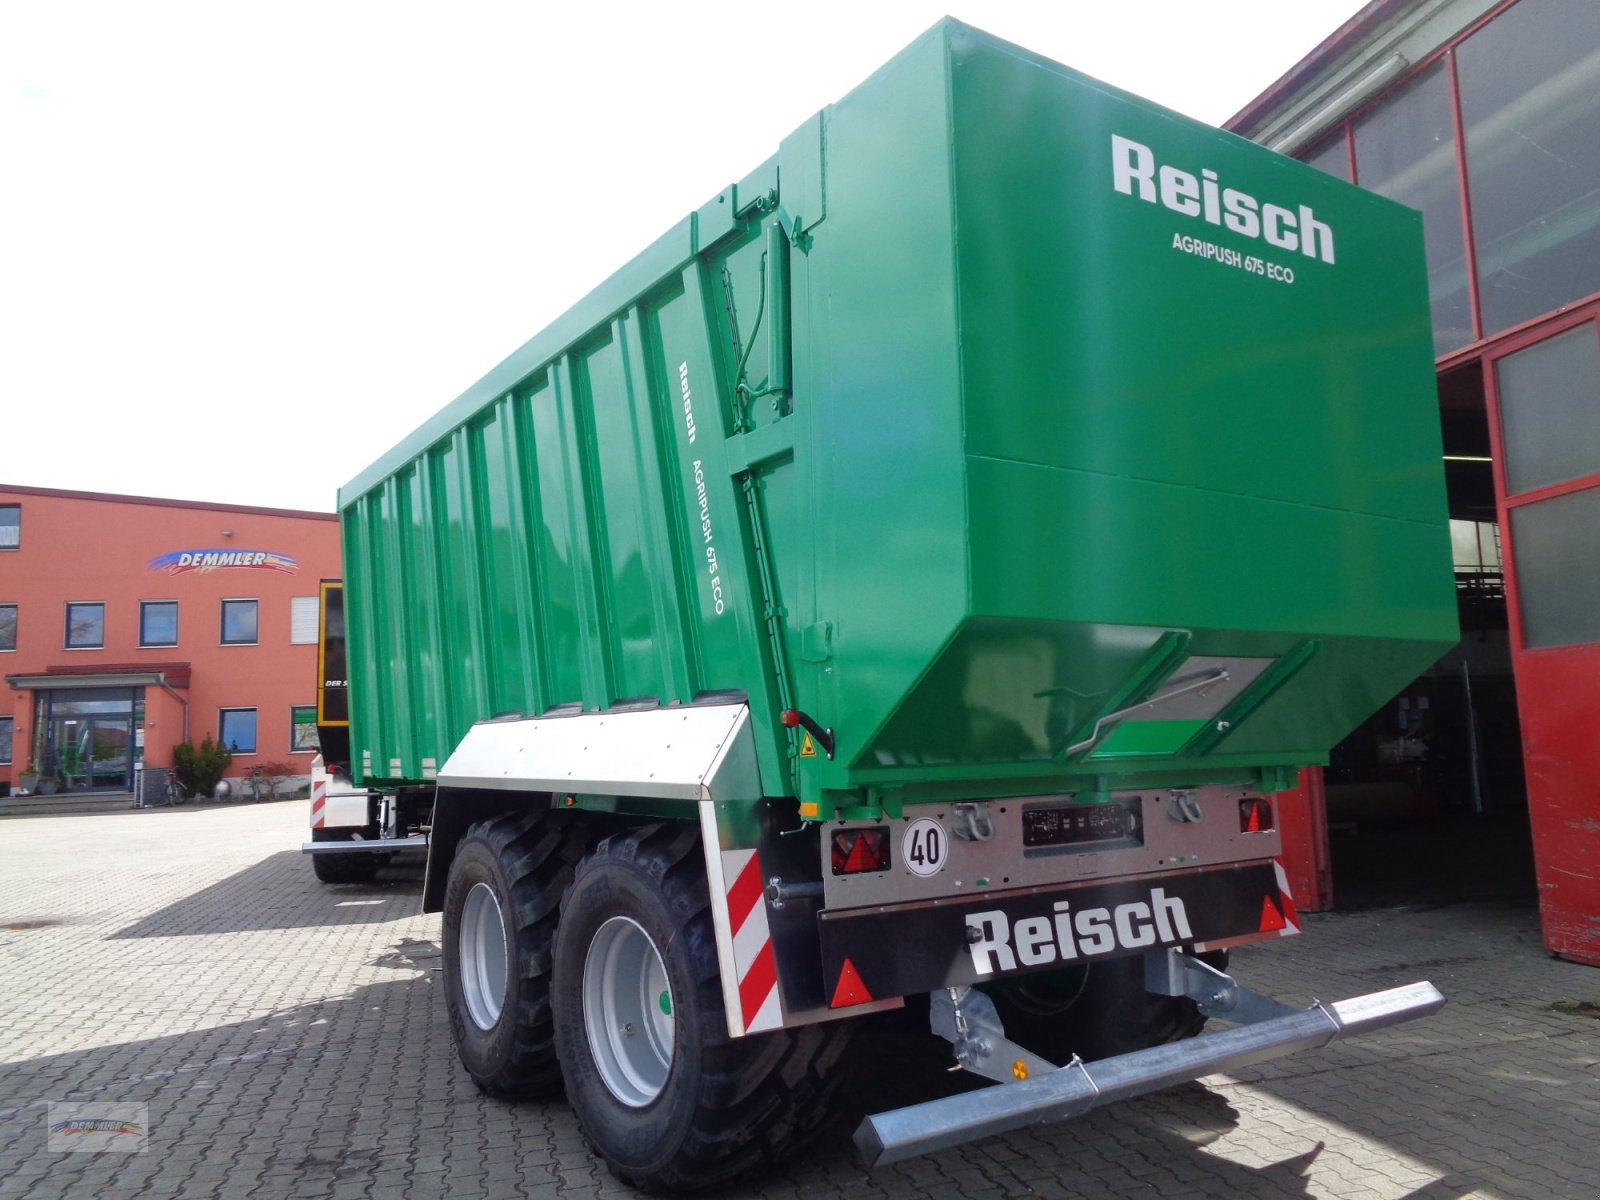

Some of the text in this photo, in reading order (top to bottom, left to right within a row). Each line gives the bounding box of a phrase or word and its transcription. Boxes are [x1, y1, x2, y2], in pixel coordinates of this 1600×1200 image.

[1111, 133, 1336, 265] Reisch
[1172, 232, 1295, 285] AGRIPUSH 675 ECO
[679, 361, 697, 445] Reisch
[177, 552, 266, 567] DEMMLER
[692, 459, 724, 615] AGRIPUSH 675 ECO
[909, 827, 940, 867] 40
[964, 887, 1194, 975] Reisch
